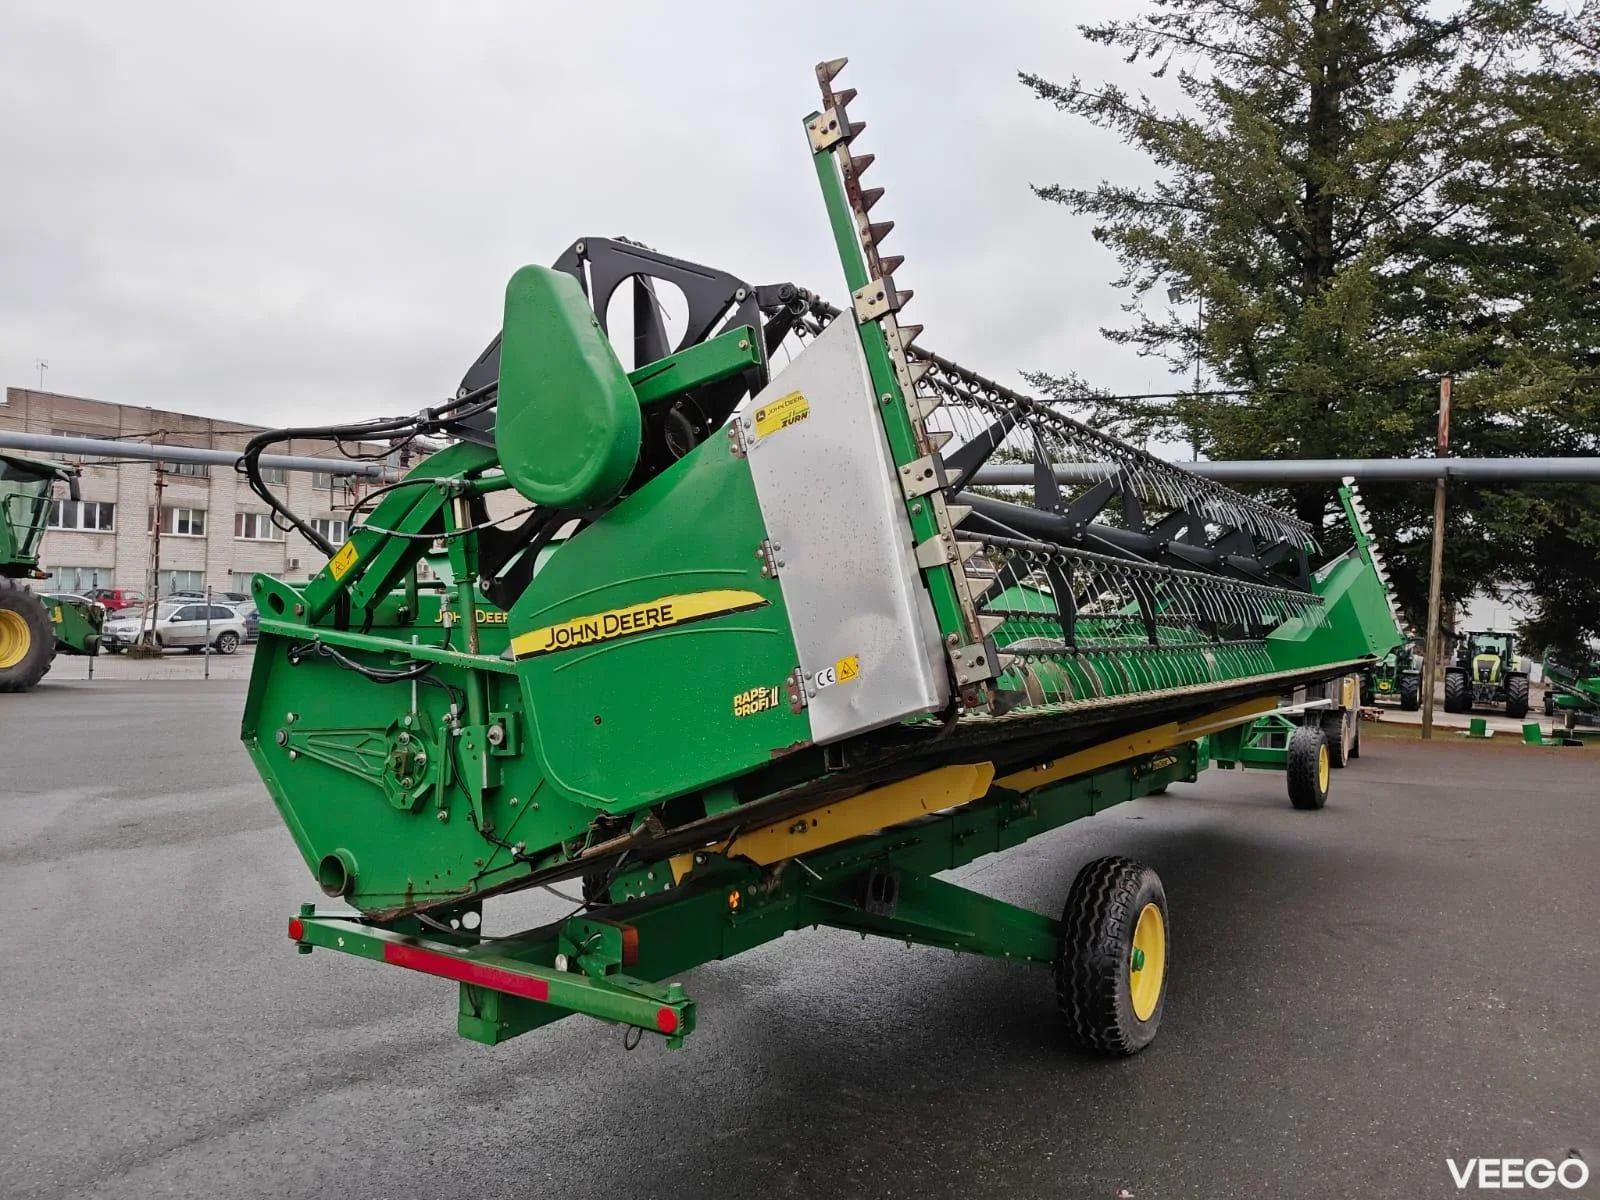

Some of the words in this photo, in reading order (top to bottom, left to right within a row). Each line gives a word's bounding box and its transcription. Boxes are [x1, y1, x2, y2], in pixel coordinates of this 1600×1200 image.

[545, 627, 599, 648] JOHN
[602, 604, 674, 635] DEERE
[734, 698, 769, 717] PROFI
